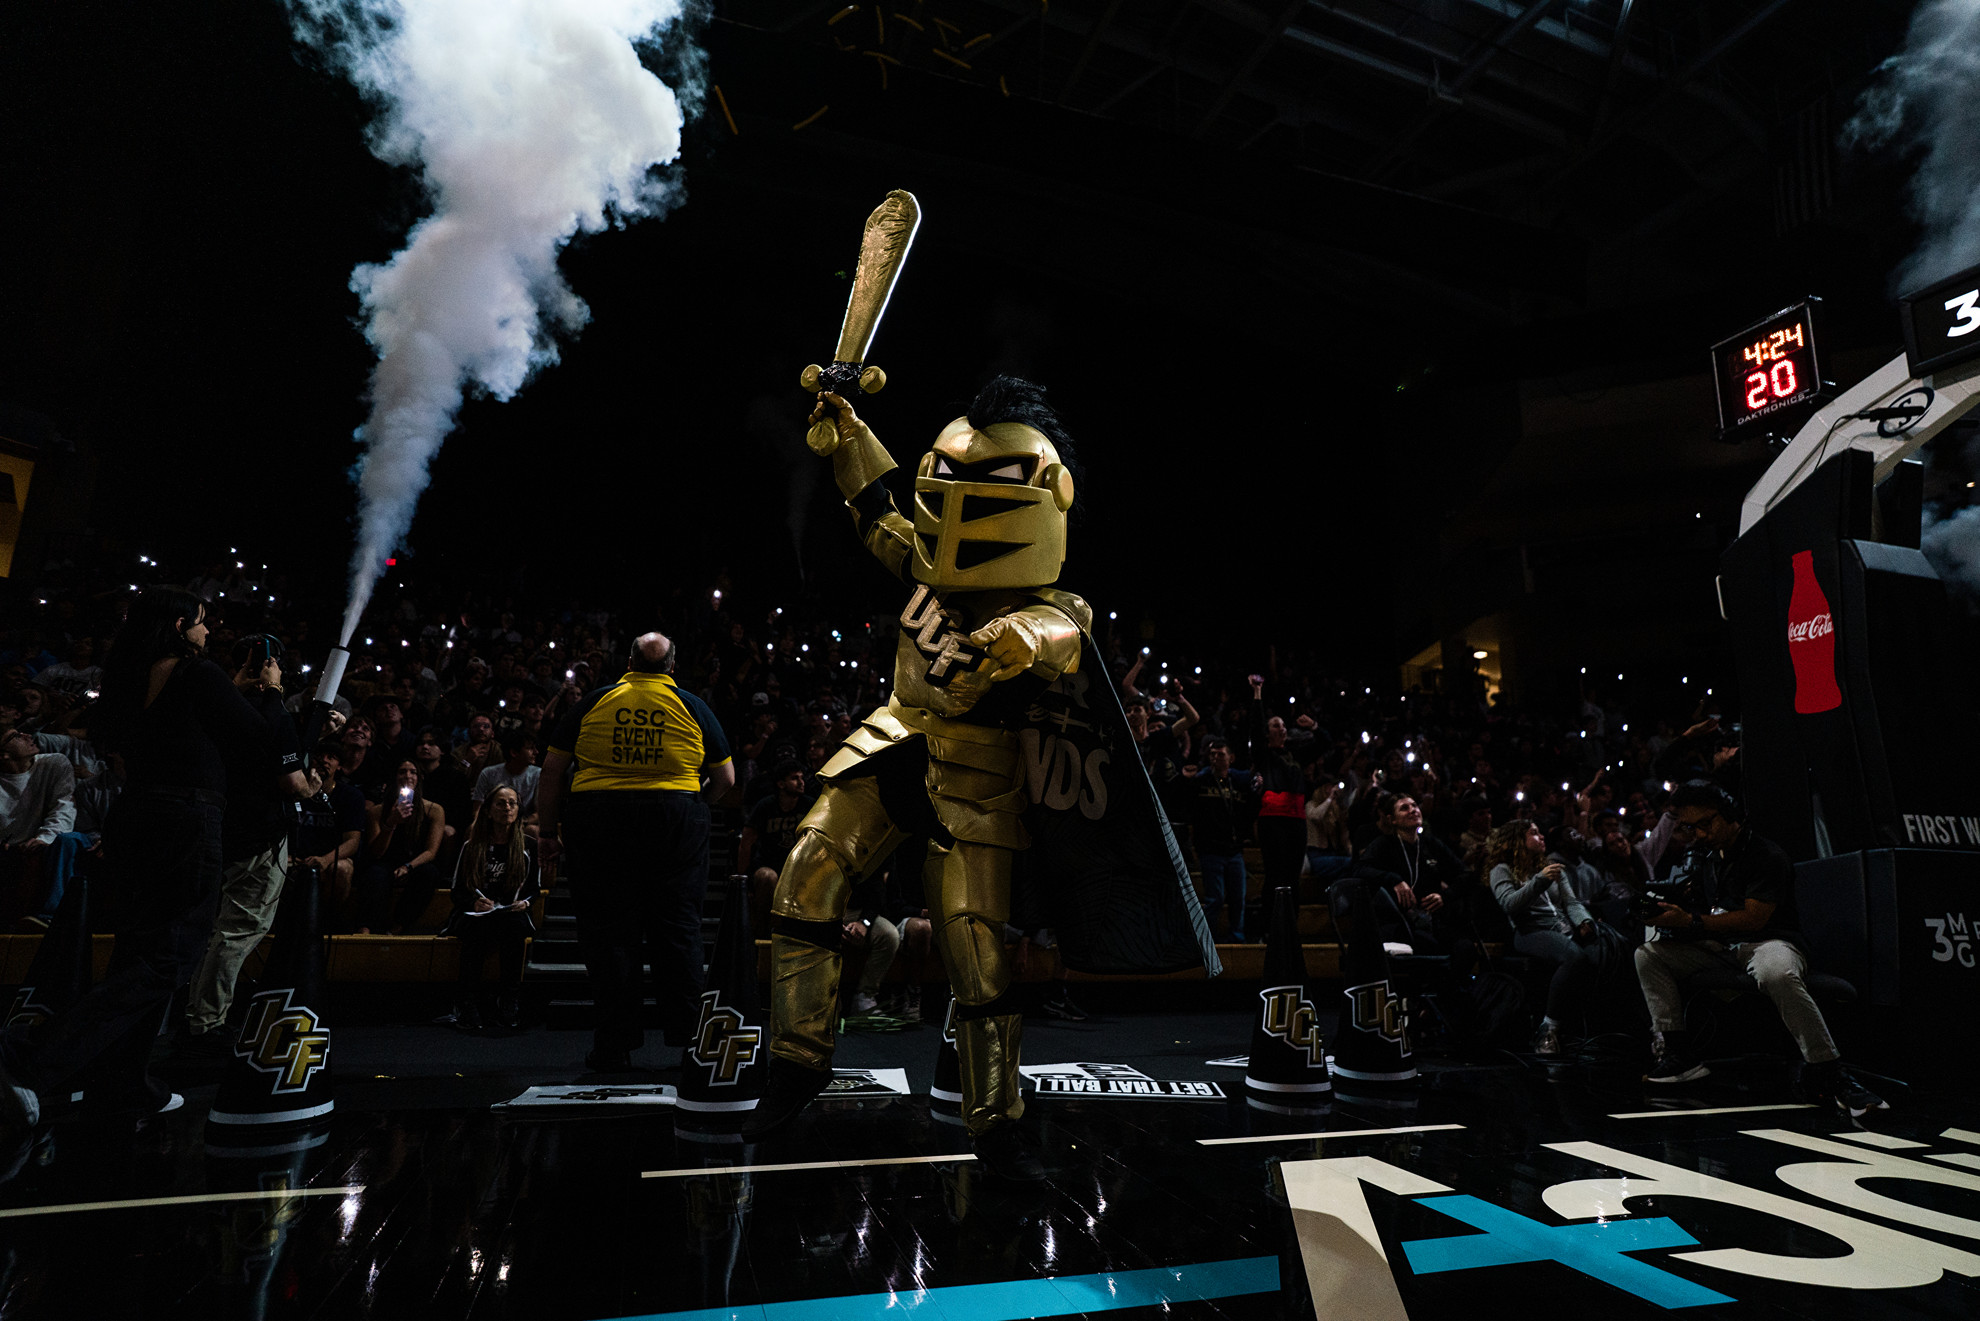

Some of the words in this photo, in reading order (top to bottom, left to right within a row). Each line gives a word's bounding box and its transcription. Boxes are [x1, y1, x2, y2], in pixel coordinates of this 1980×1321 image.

[1744, 323, 1803, 365] 4:24
[1747, 359, 1797, 408] 20
[1736, 394, 1806, 426] DAKTRONICS
[900, 584, 985, 678] UCF
[1788, 612, 1834, 643] Coca-Cola
[615, 707, 666, 727] CSC
[612, 726, 666, 747] EVENT
[611, 746, 664, 765] STAFF
[1902, 813, 1961, 845] FIRST
[233, 988, 331, 1095] UCF
[1046, 1078, 1097, 1092] BALL
[1107, 1080, 1165, 1095] THAT
[1169, 1081, 1215, 1096] GET
